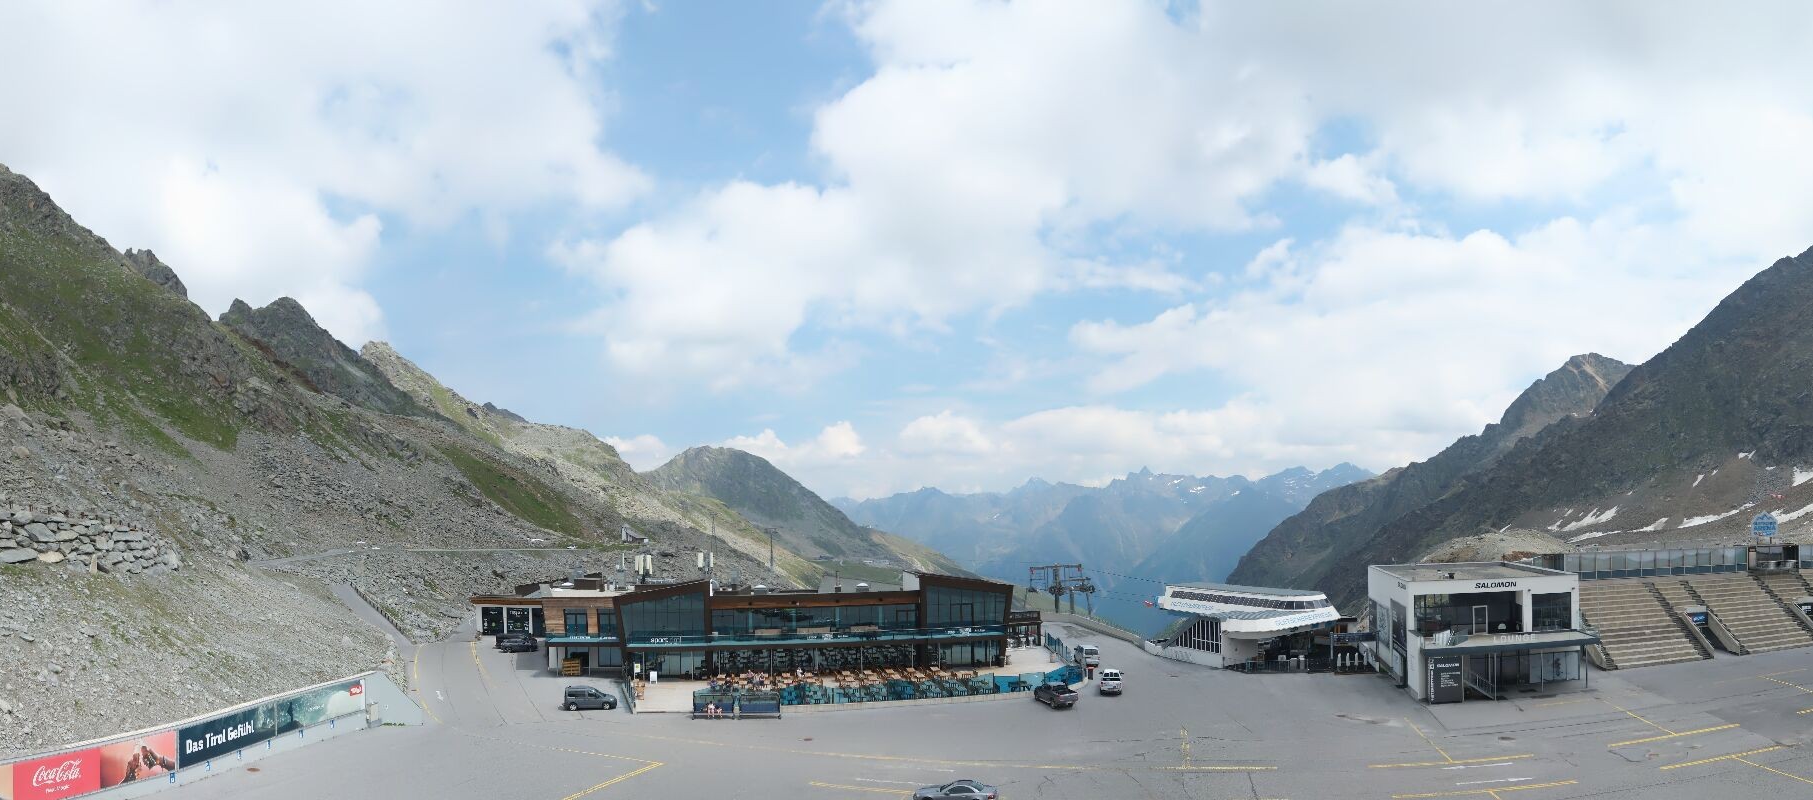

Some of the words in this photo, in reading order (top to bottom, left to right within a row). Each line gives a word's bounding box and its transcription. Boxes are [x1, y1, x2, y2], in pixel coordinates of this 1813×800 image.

[1475, 581, 1517, 589] SALOMON
[1493, 634, 1536, 643] LOUNGE
[186, 738, 204, 755] Das
[205, 732, 227, 749] Tirol
[228, 719, 255, 741] Gefühl
[32, 758, 82, 787] Coca-Cola
